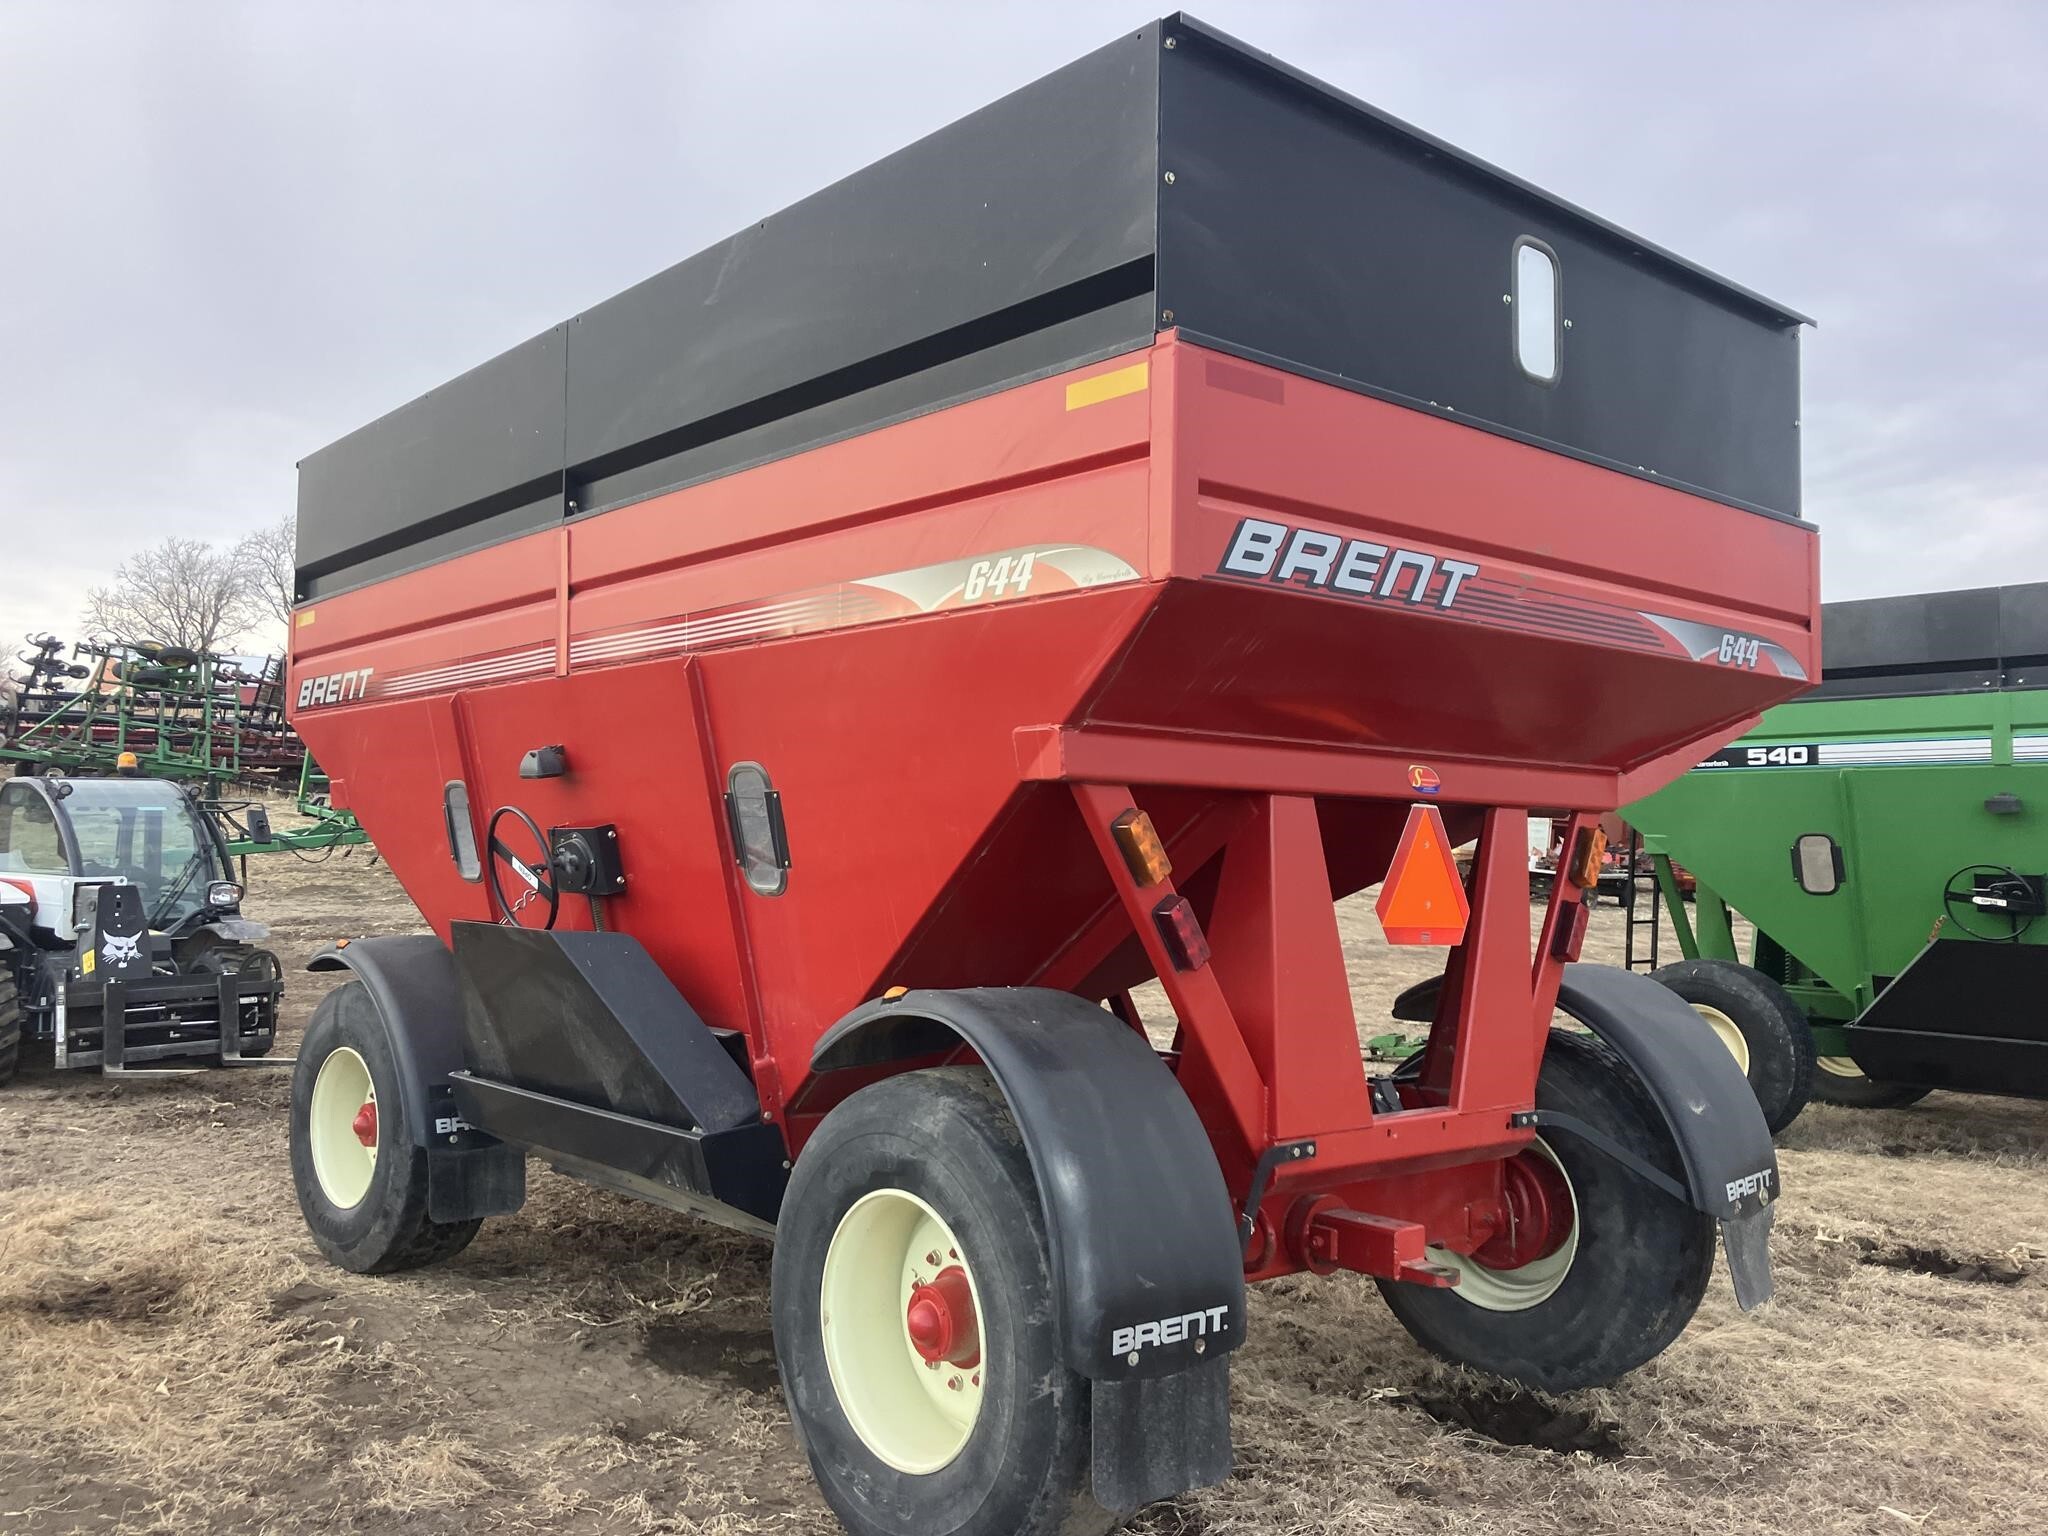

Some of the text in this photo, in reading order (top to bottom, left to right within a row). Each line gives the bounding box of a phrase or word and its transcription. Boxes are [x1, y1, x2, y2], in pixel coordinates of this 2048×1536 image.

[963, 552, 1036, 601] 644
[1219, 517, 1480, 609] BRENT
[1718, 634, 1760, 668] 644
[297, 668, 374, 708] BRENT
[1747, 746, 1808, 765] 540
